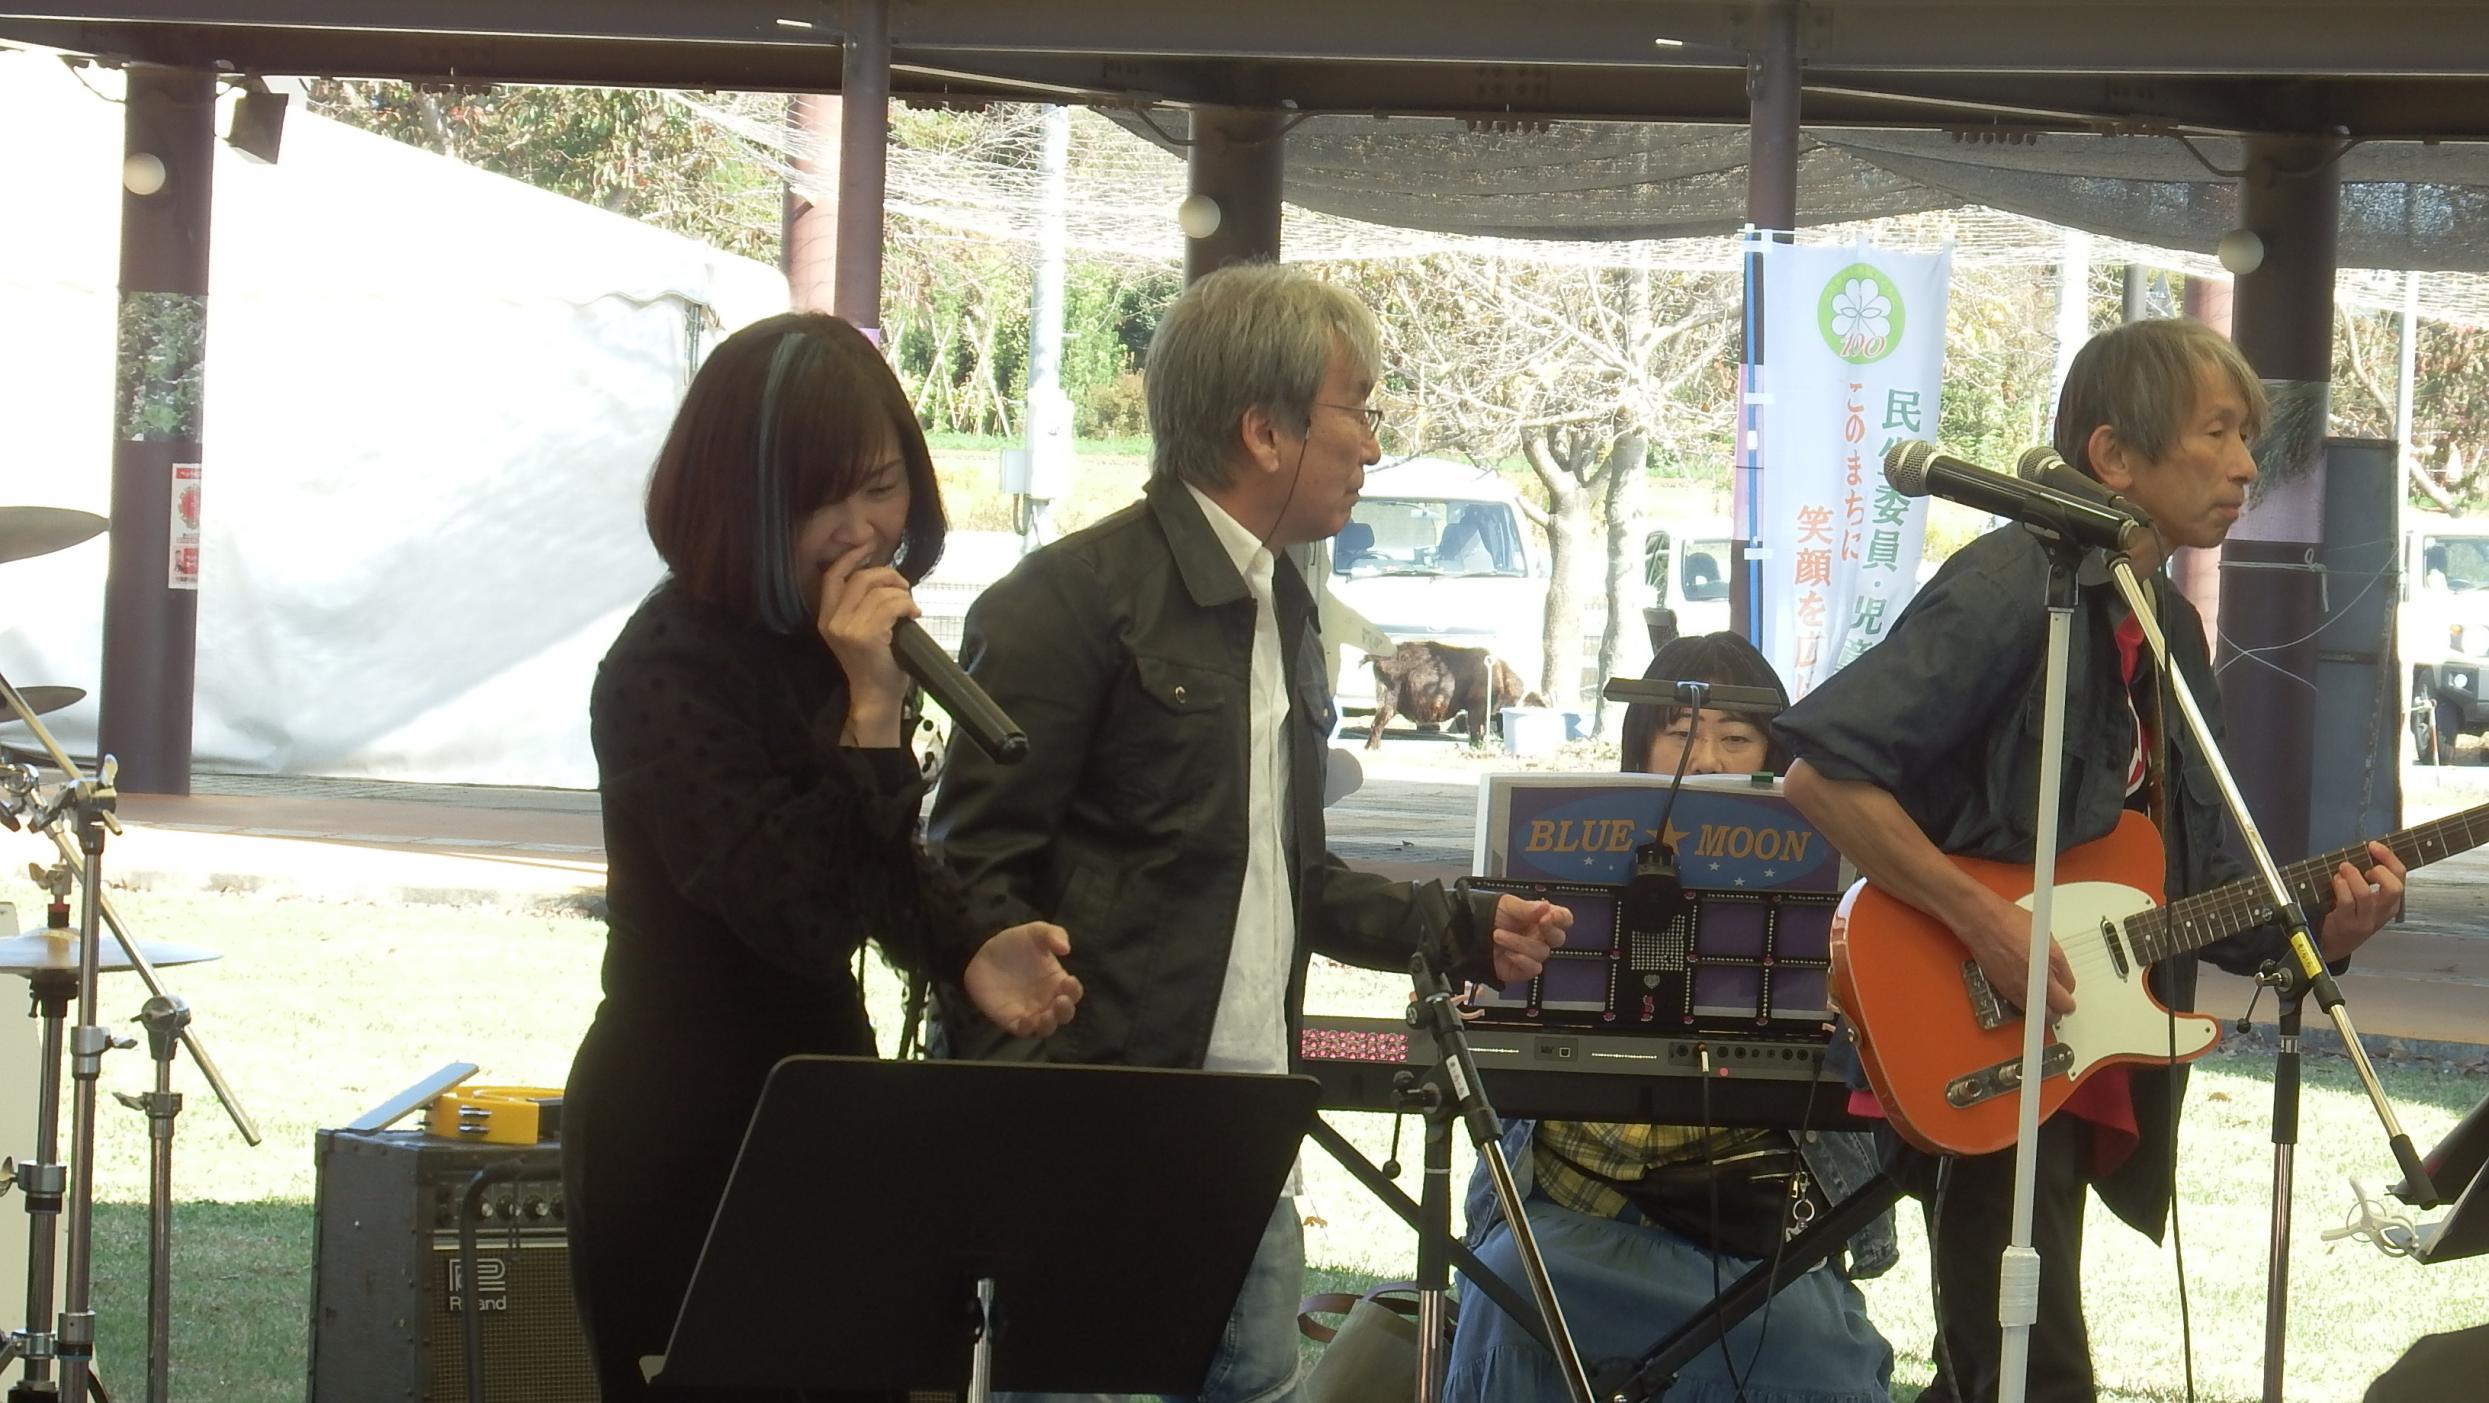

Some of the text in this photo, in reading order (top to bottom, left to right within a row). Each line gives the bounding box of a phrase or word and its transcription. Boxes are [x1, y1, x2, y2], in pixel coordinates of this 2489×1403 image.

[1840, 331, 1888, 357] 100
[1840, 382, 1866, 562] このまちに
[1835, 388, 1922, 672] 民委員・児
[1525, 819, 1813, 862] BLUE MOON
[449, 1295, 507, 1311] Rand
